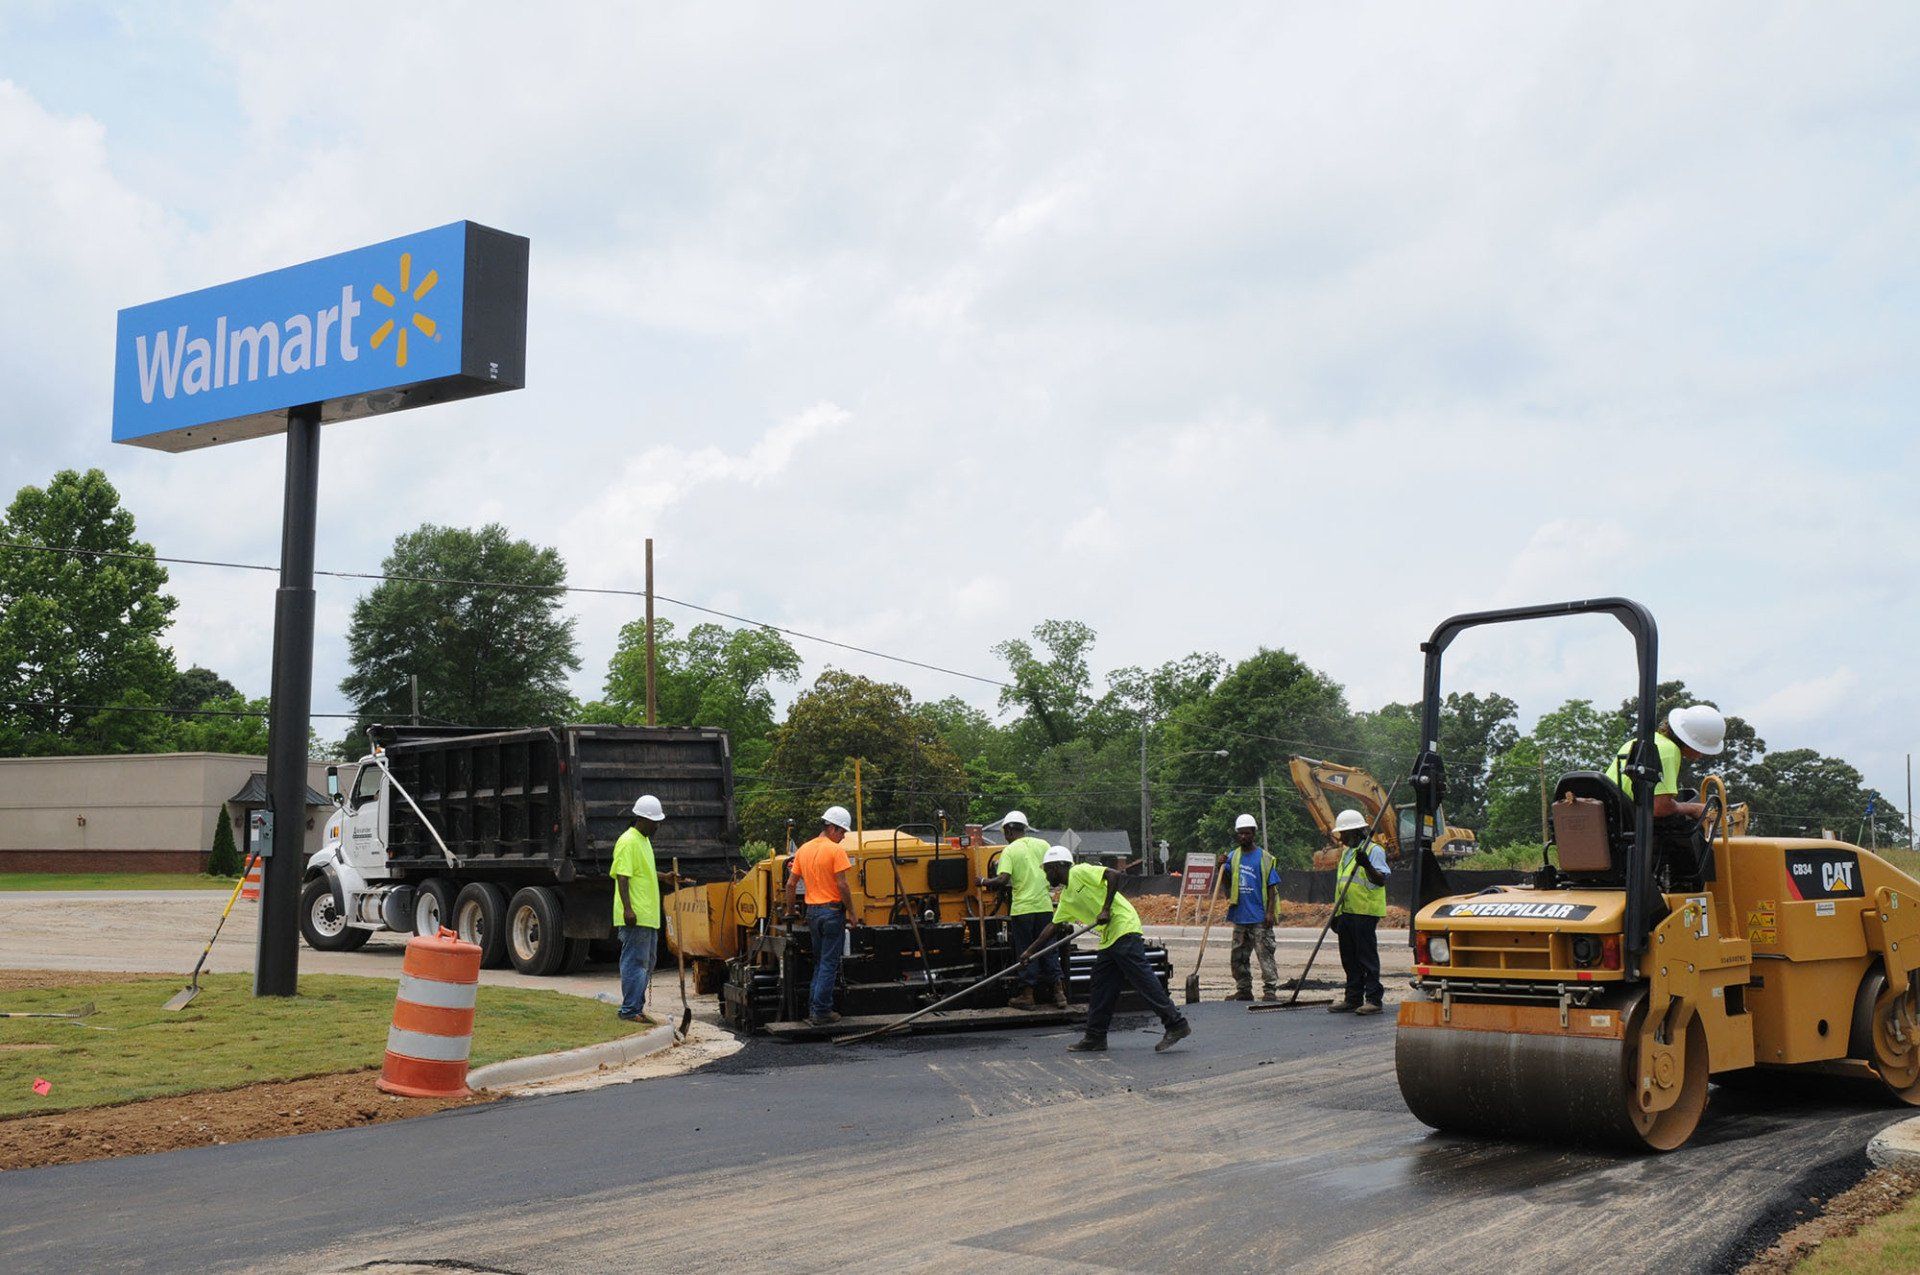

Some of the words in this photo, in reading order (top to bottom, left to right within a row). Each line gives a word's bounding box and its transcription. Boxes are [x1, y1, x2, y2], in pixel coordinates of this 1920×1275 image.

[136, 284, 361, 404] Walmart
[1792, 863, 1813, 876] CB34
[1821, 861, 1854, 892] CAT
[1450, 902, 1575, 918] CATERPILLAR
